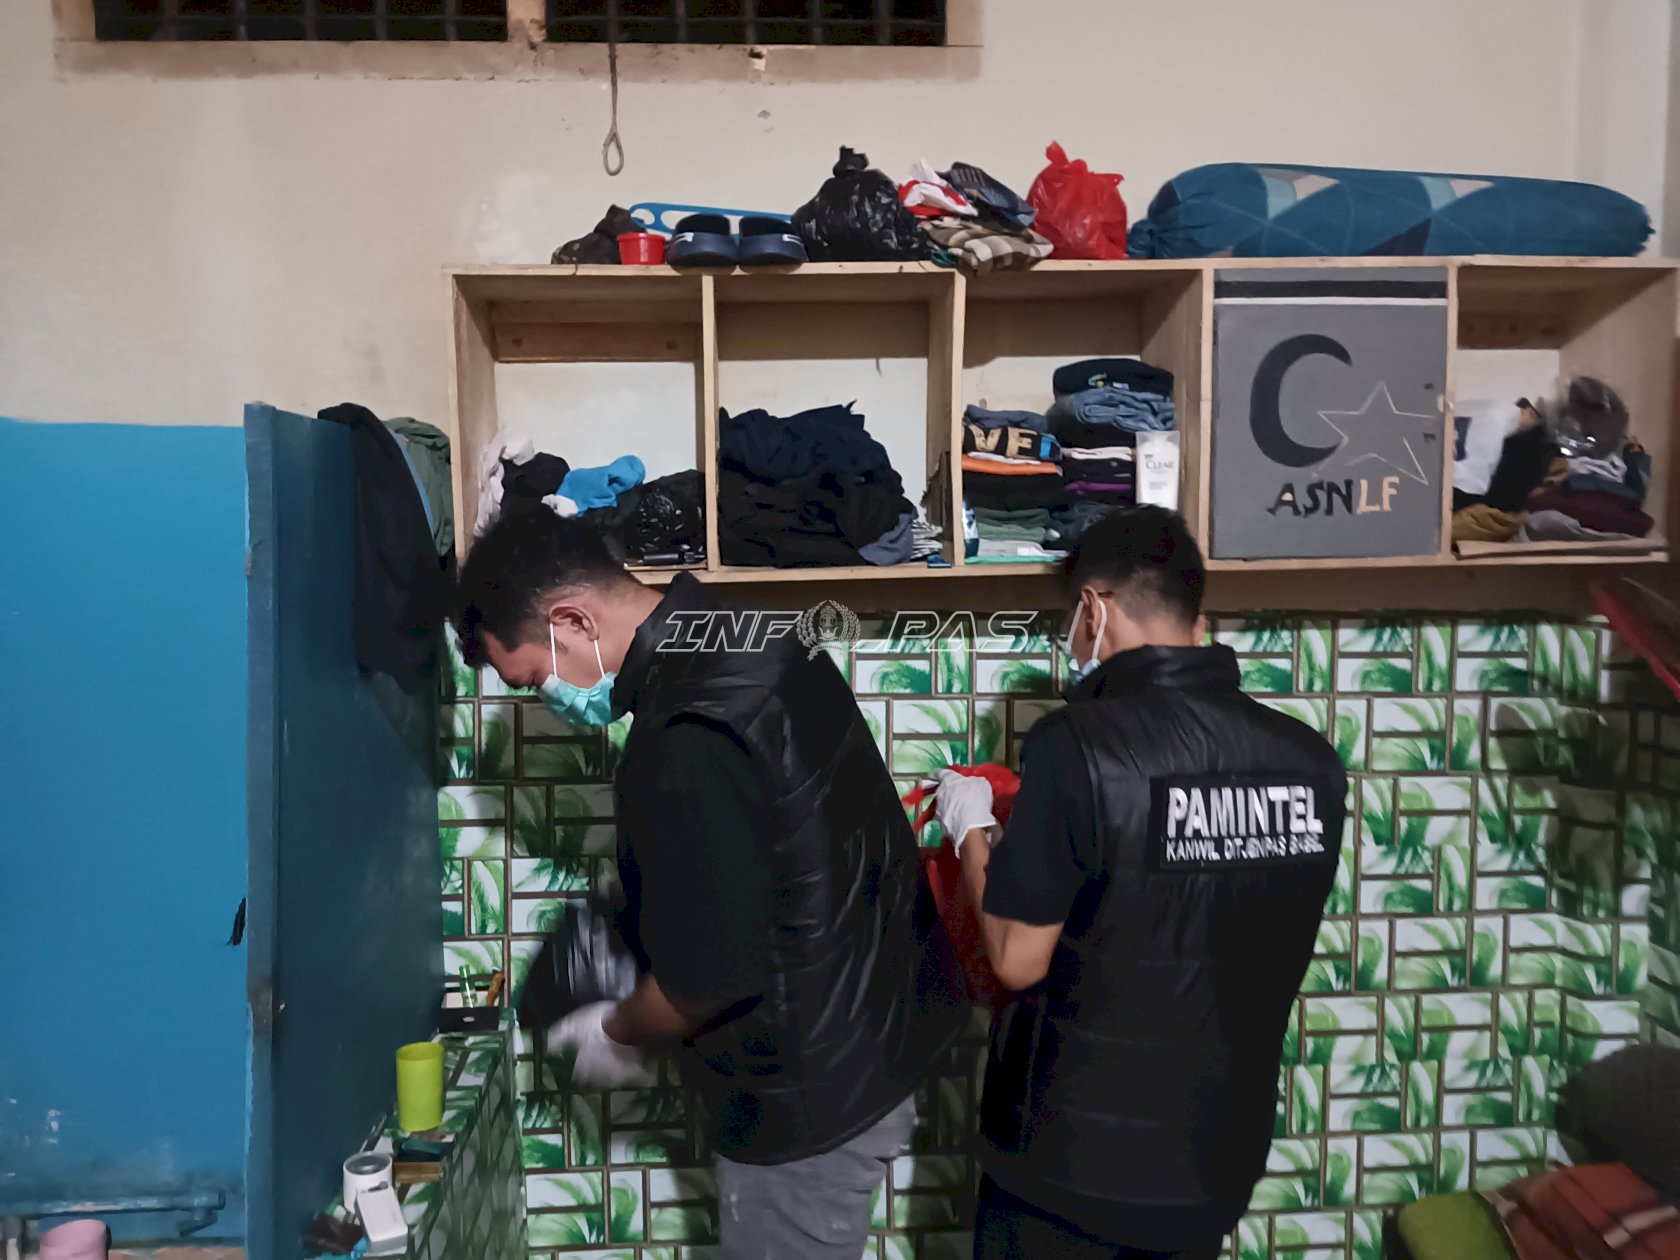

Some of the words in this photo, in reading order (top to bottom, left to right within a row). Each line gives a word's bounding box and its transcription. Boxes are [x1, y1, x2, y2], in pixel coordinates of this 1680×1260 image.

[1266, 475, 1400, 518] ASNLF
[1167, 786, 1323, 838] PAMINTEL
[1166, 838, 1220, 861] KANWIL
